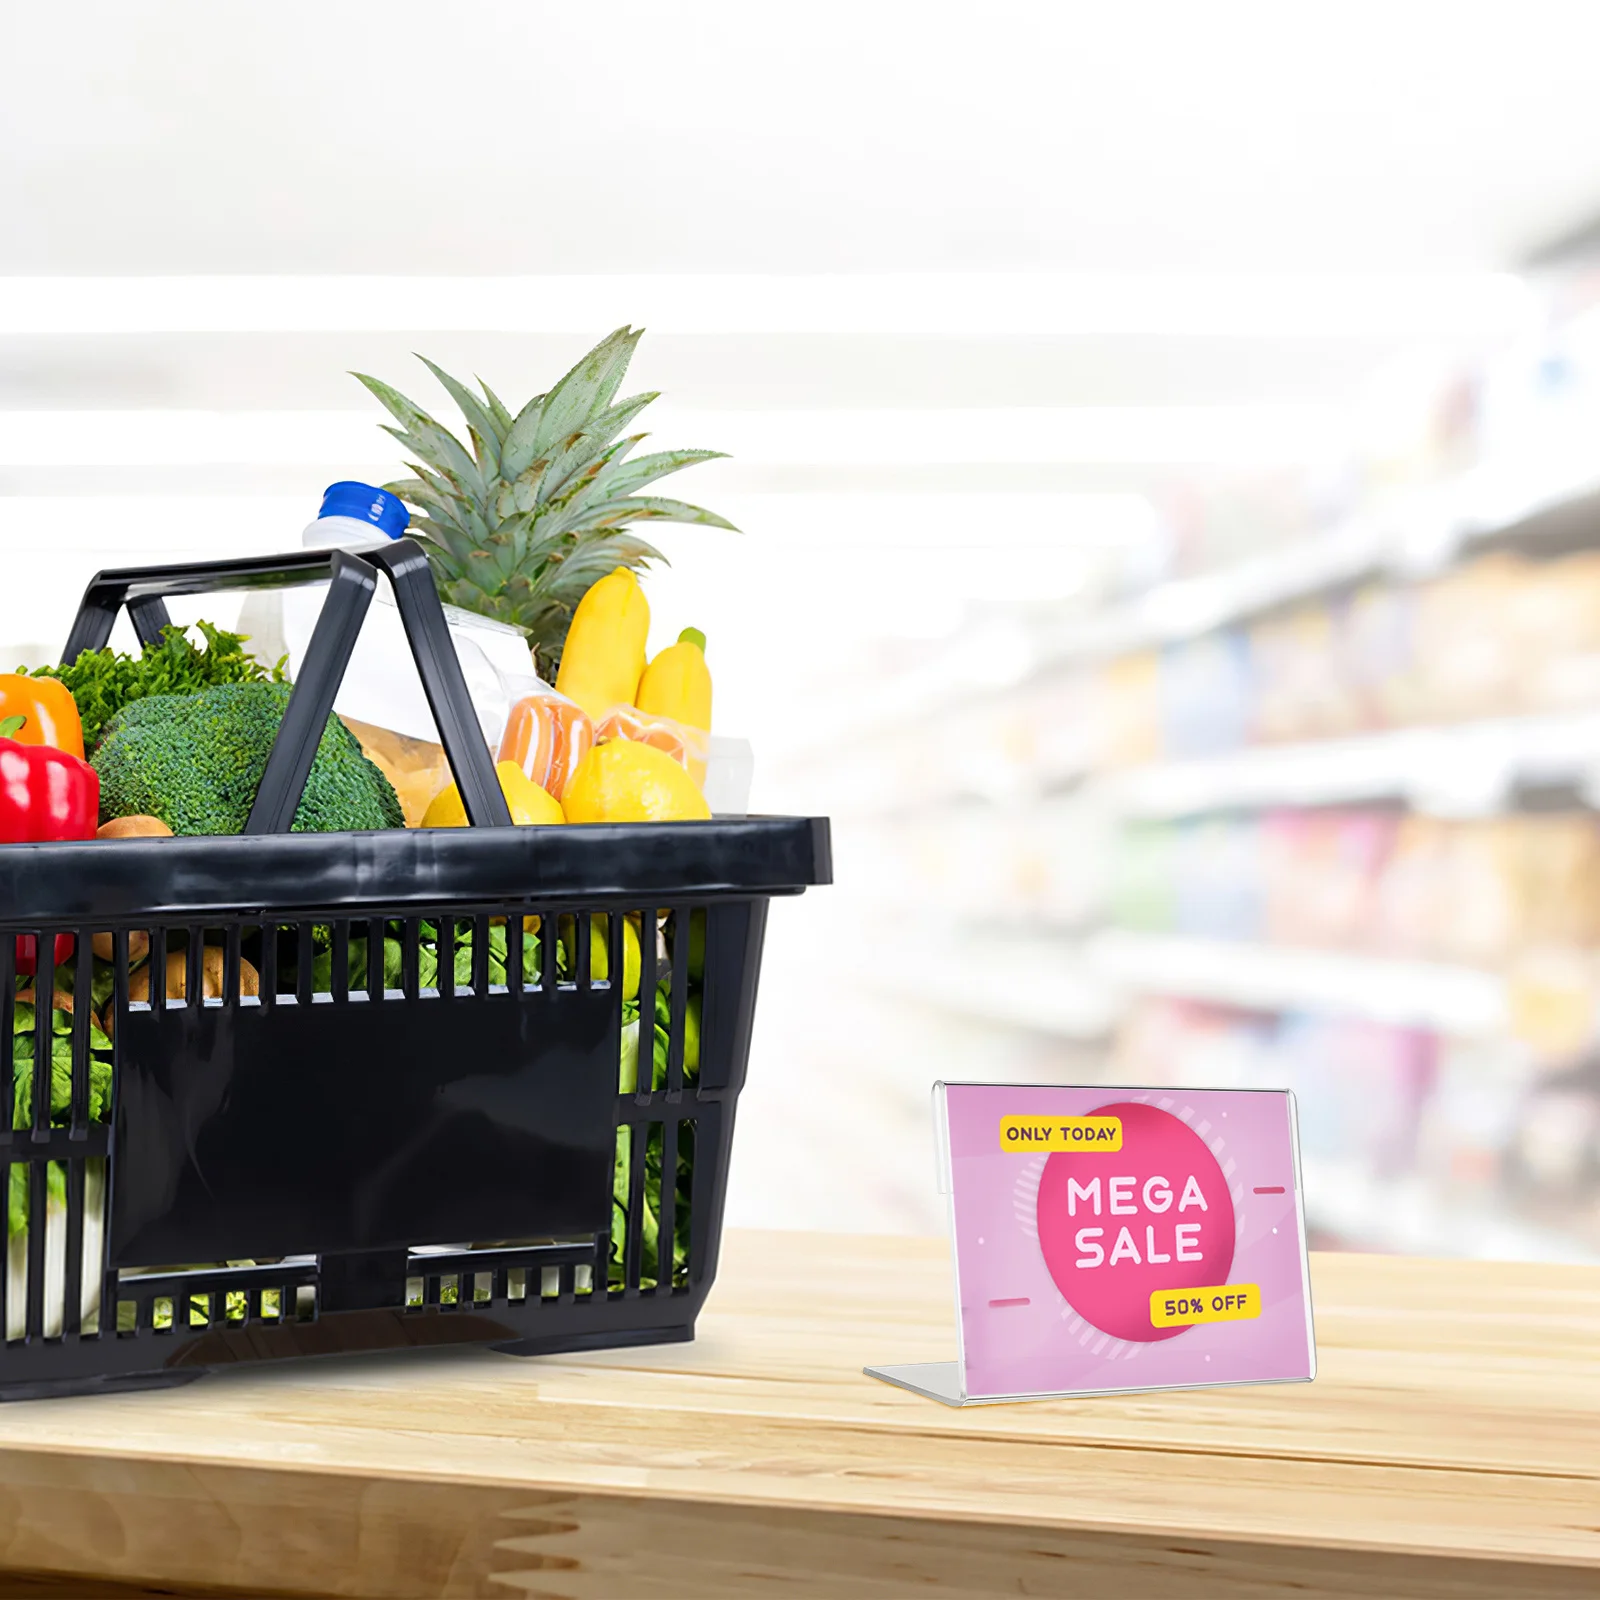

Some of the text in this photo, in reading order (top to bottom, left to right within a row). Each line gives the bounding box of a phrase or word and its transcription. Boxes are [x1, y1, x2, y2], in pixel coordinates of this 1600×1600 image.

[1006, 1126, 1117, 1141] ONLY TODAY
[1067, 1175, 1208, 1216] MEGA
[1075, 1223, 1203, 1268] SALE
[1164, 1294, 1247, 1316] 50% OFF
